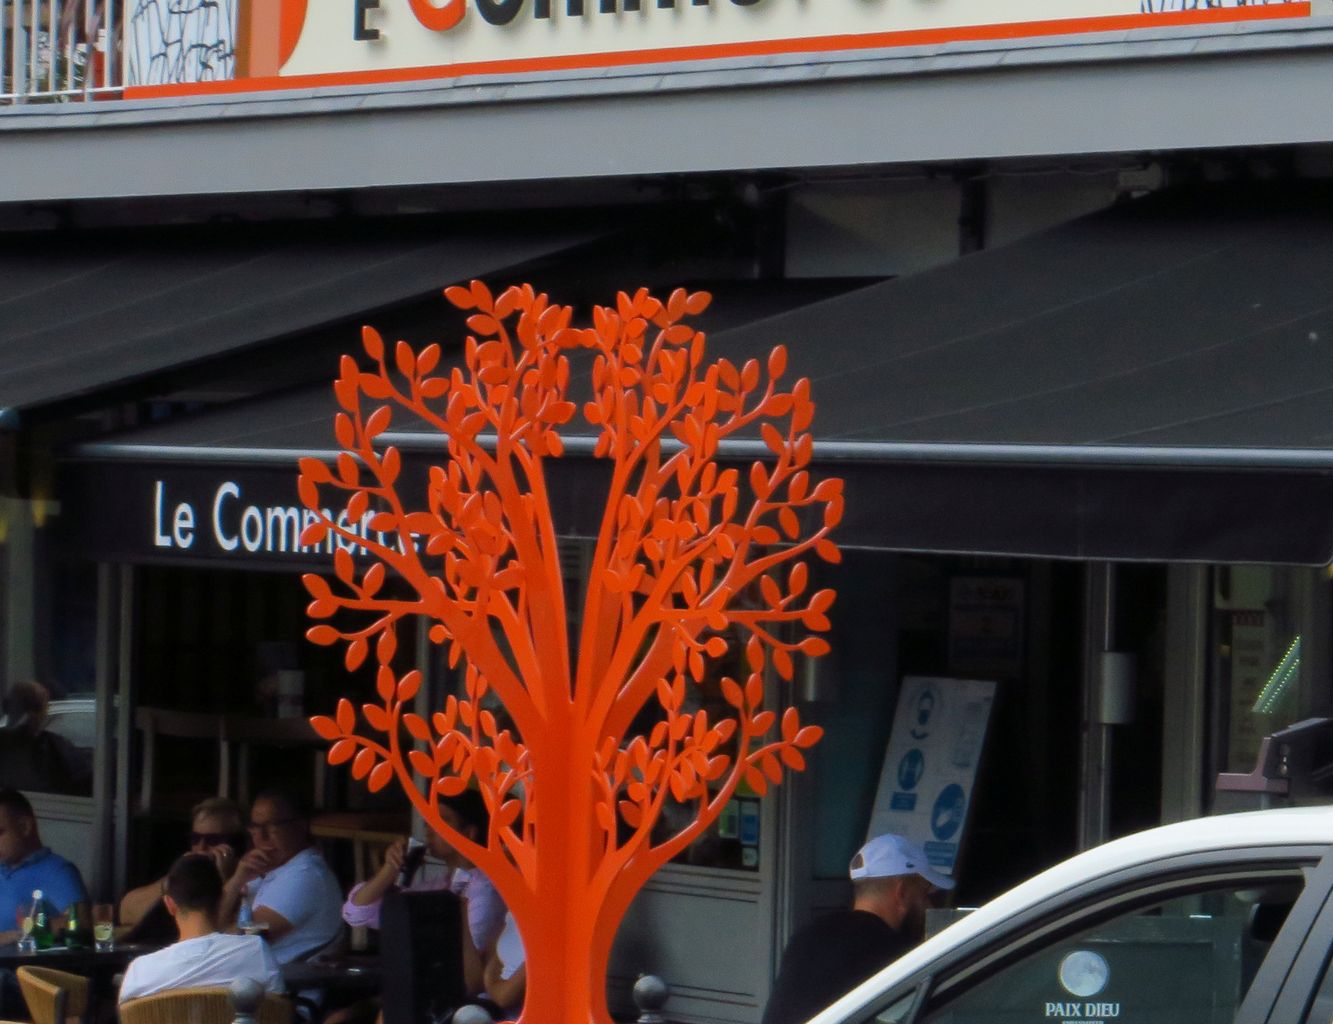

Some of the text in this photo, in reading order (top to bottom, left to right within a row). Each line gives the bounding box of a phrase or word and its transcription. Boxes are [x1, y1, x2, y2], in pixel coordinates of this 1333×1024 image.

[155, 481, 195, 549] Le
[1045, 1002, 1120, 1017] PAIX DIEU
